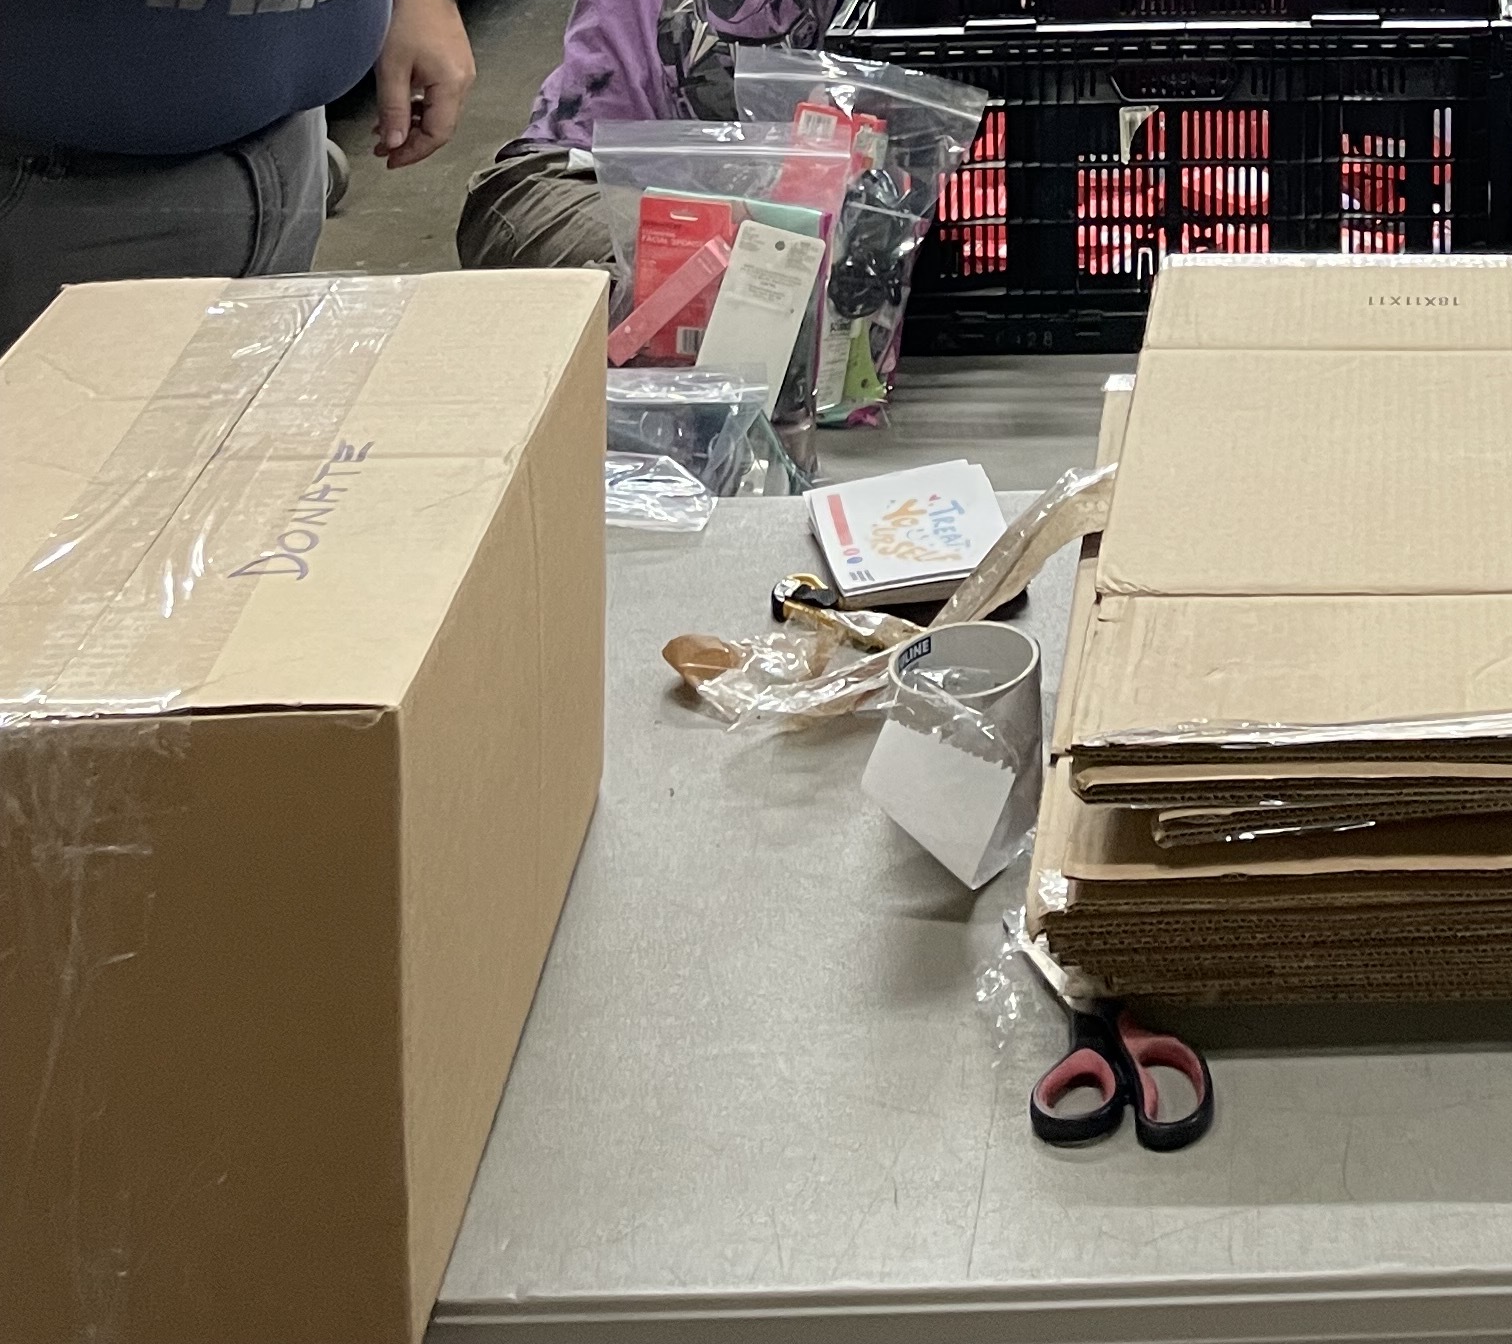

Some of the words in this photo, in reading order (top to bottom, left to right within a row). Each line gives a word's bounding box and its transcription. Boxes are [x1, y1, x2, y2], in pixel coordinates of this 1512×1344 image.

[1368, 295, 1459, 306] 18X11X11
[227, 439, 375, 581] DONATE
[929, 499, 971, 549] TREAT
